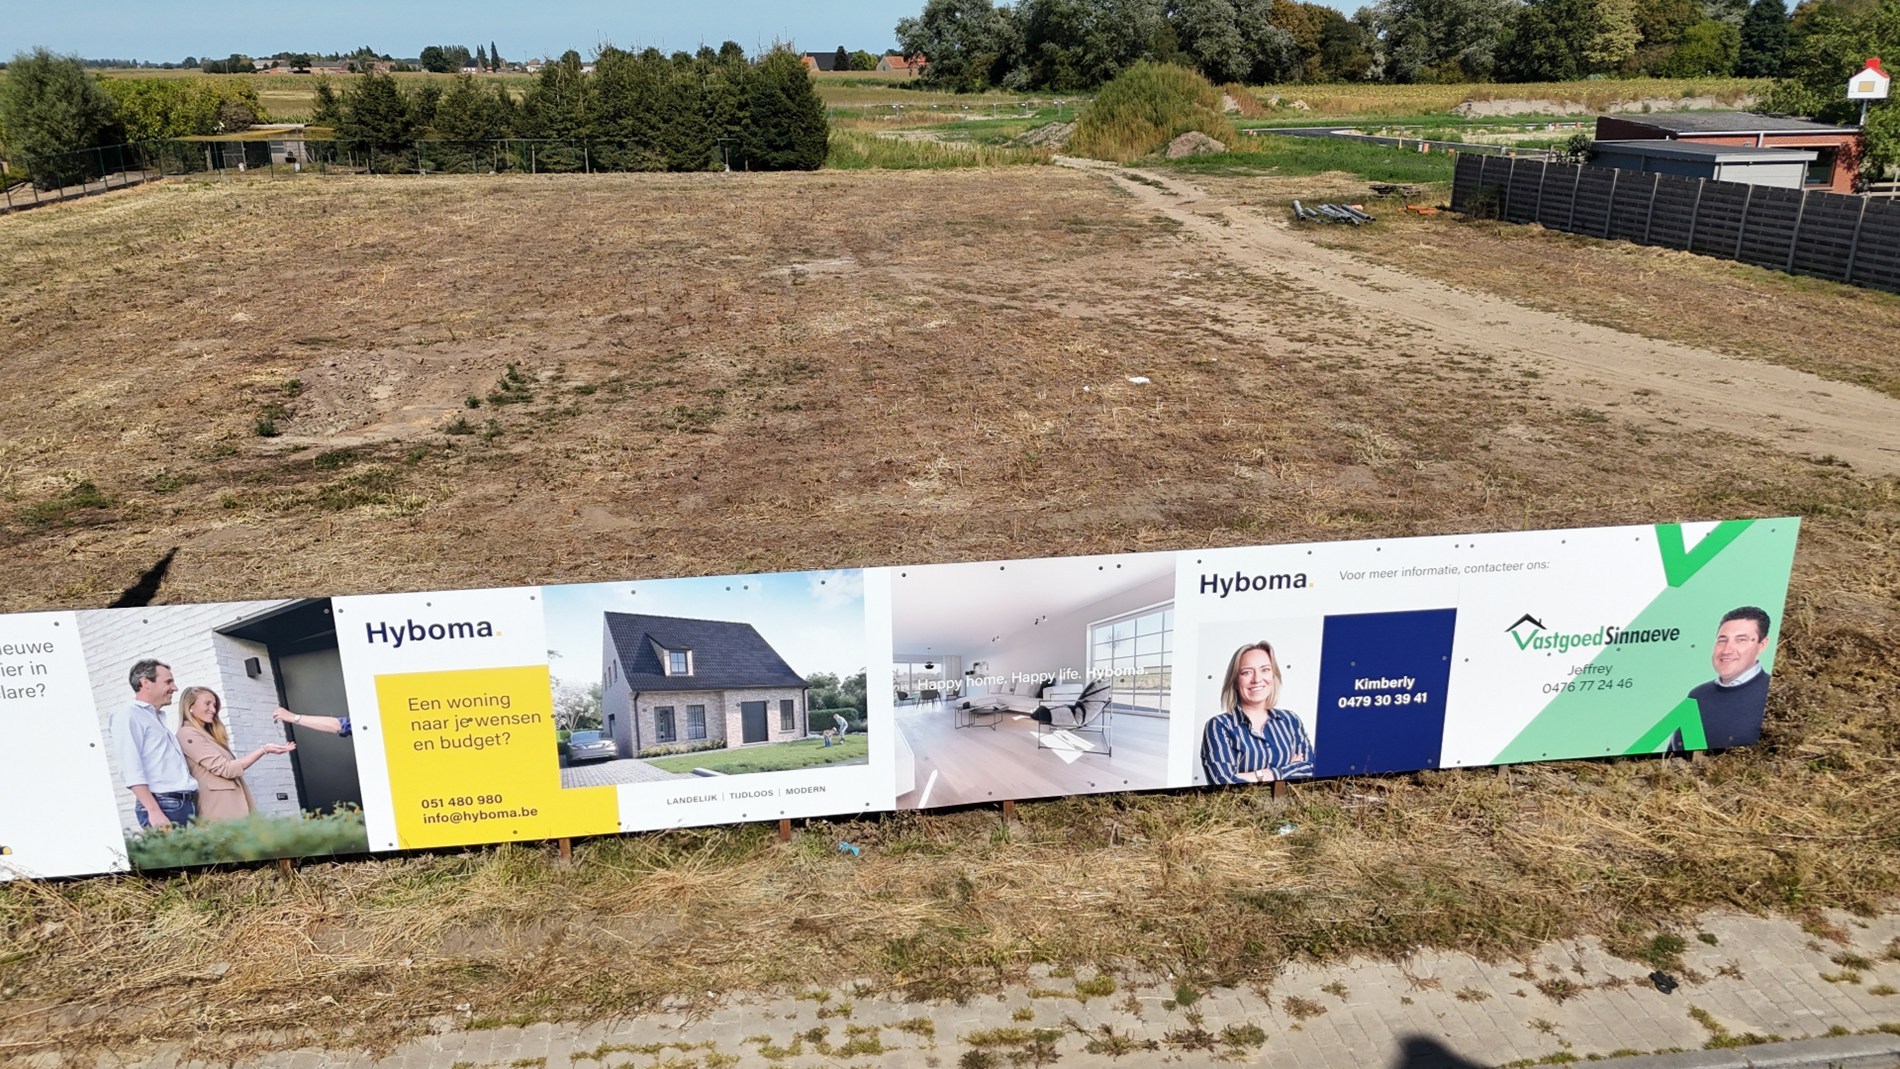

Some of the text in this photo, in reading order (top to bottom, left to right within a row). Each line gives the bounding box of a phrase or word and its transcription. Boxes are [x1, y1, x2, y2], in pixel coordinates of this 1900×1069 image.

[1339, 560, 1550, 581] Voor meer informatie, contacteer ons:
[29, 660, 47, 675] in
[1567, 663, 1613, 676] Jeffrey
[917, 678, 963, 693] Happy
[966, 674, 1007, 688] home.
[1011, 671, 1057, 686] Happy
[1059, 667, 1081, 681] life.
[1354, 675, 1415, 692] Kimberly
[1542, 678, 1633, 694] 0476 77 24 46
[0, 683, 46, 699] lare?
[1338, 692, 1428, 708] 0479 30 39 41
[408, 693, 511, 712] Een woning
[410, 711, 542, 732] naar je wensen
[413, 731, 511, 751] en budget?
[421, 794, 503, 809] 051 480 980
[666, 785, 826, 805] LANDELIJK TIJDLOOS MODERN
[423, 806, 538, 825] info@hyboma.be
